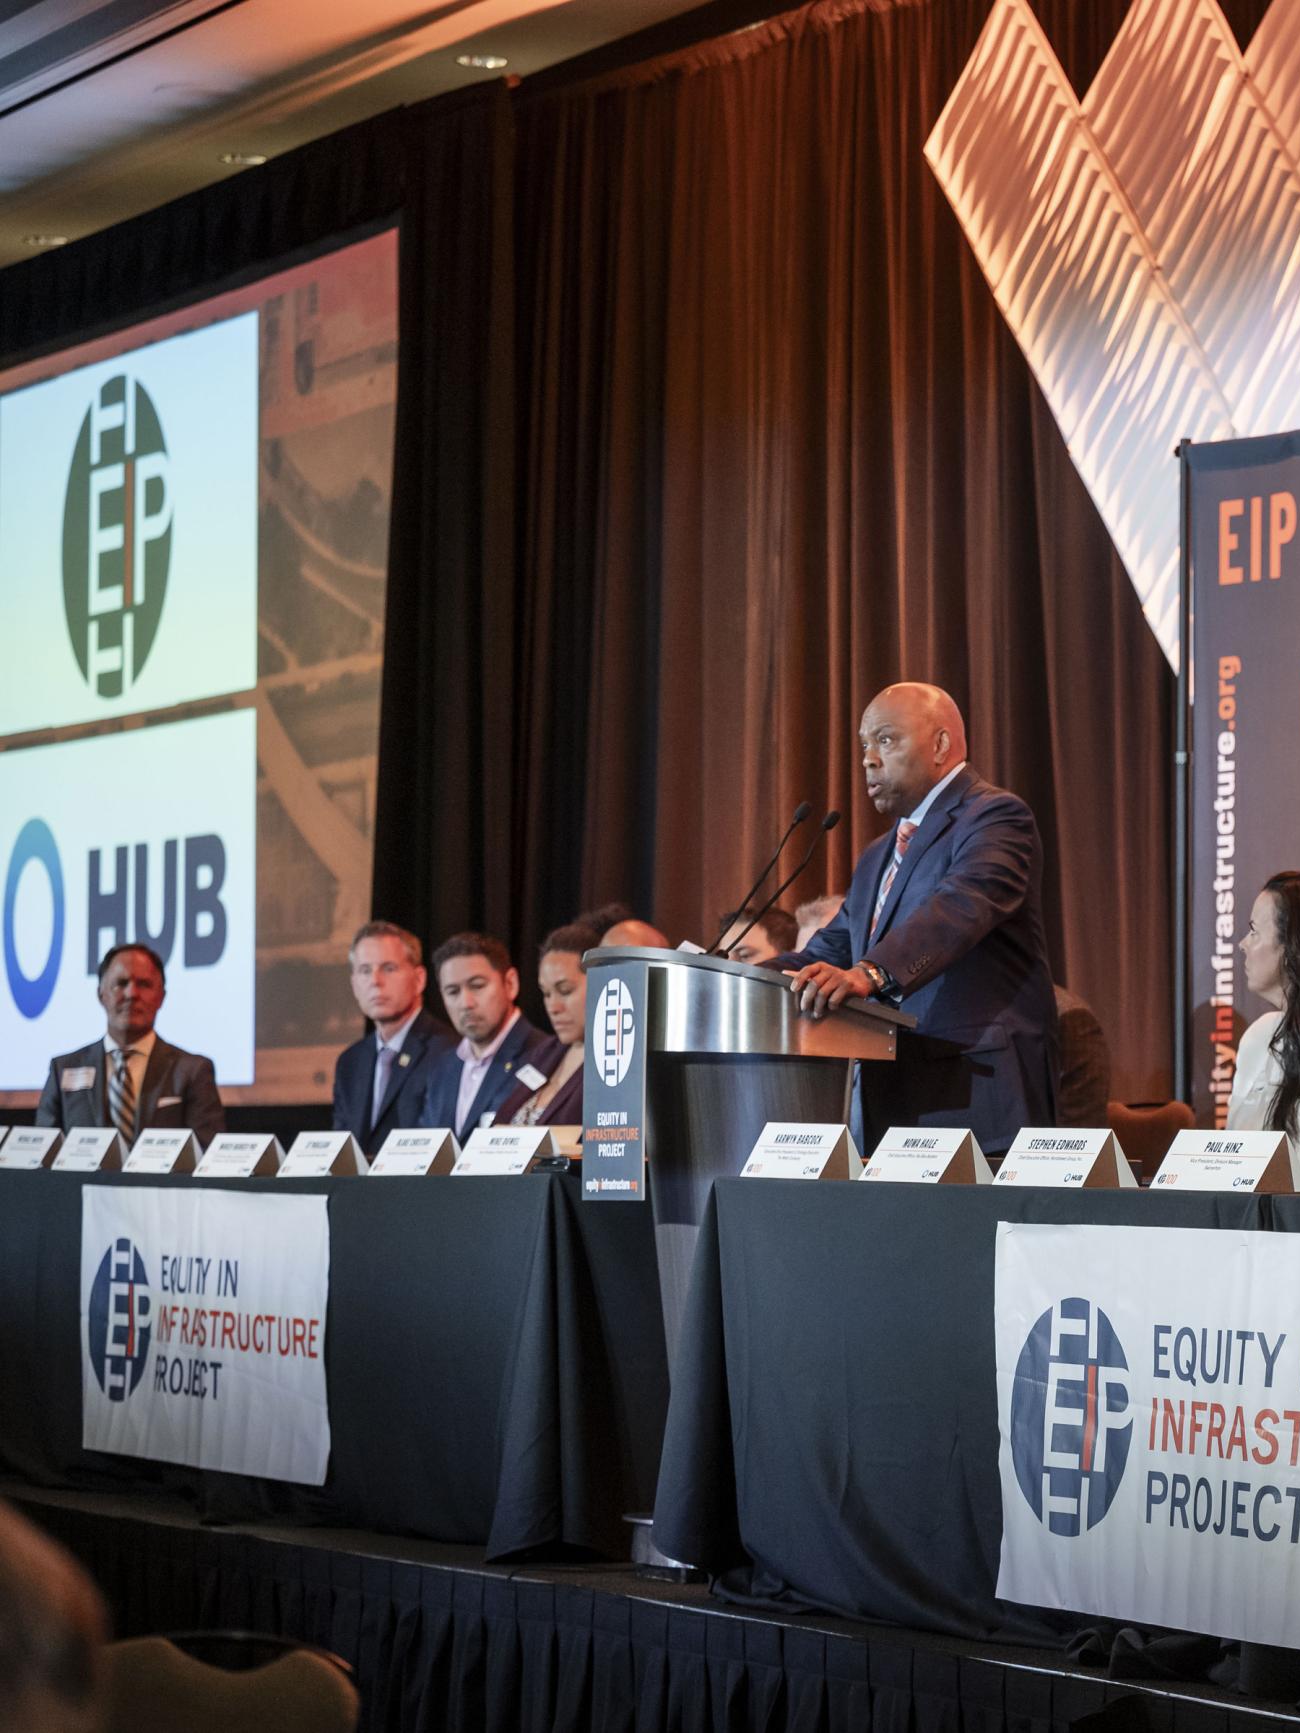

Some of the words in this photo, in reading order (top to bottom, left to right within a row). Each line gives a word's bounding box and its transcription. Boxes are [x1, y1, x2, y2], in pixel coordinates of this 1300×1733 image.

[1218, 493, 1297, 586] EIP
[87, 834, 227, 976] HUB
[597, 1112, 619, 1127] EQUITY
[620, 1112, 627, 1126] IN
[586, 1128, 639, 1141] INFRASTRUCTURE
[1028, 1139, 1058, 1150] STEPHEN
[1056, 1140, 1087, 1151] EDWARDS
[1204, 1141, 1223, 1152] PAUL
[1222, 1142, 1244, 1153] HINZ
[598, 1143, 626, 1157] PROJECT
[161, 1255, 211, 1296] EQUITY
[217, 1259, 239, 1298] IN
[156, 1304, 319, 1359] INFRASTRUCTURE
[1153, 1324, 1286, 1388] EQUITY
